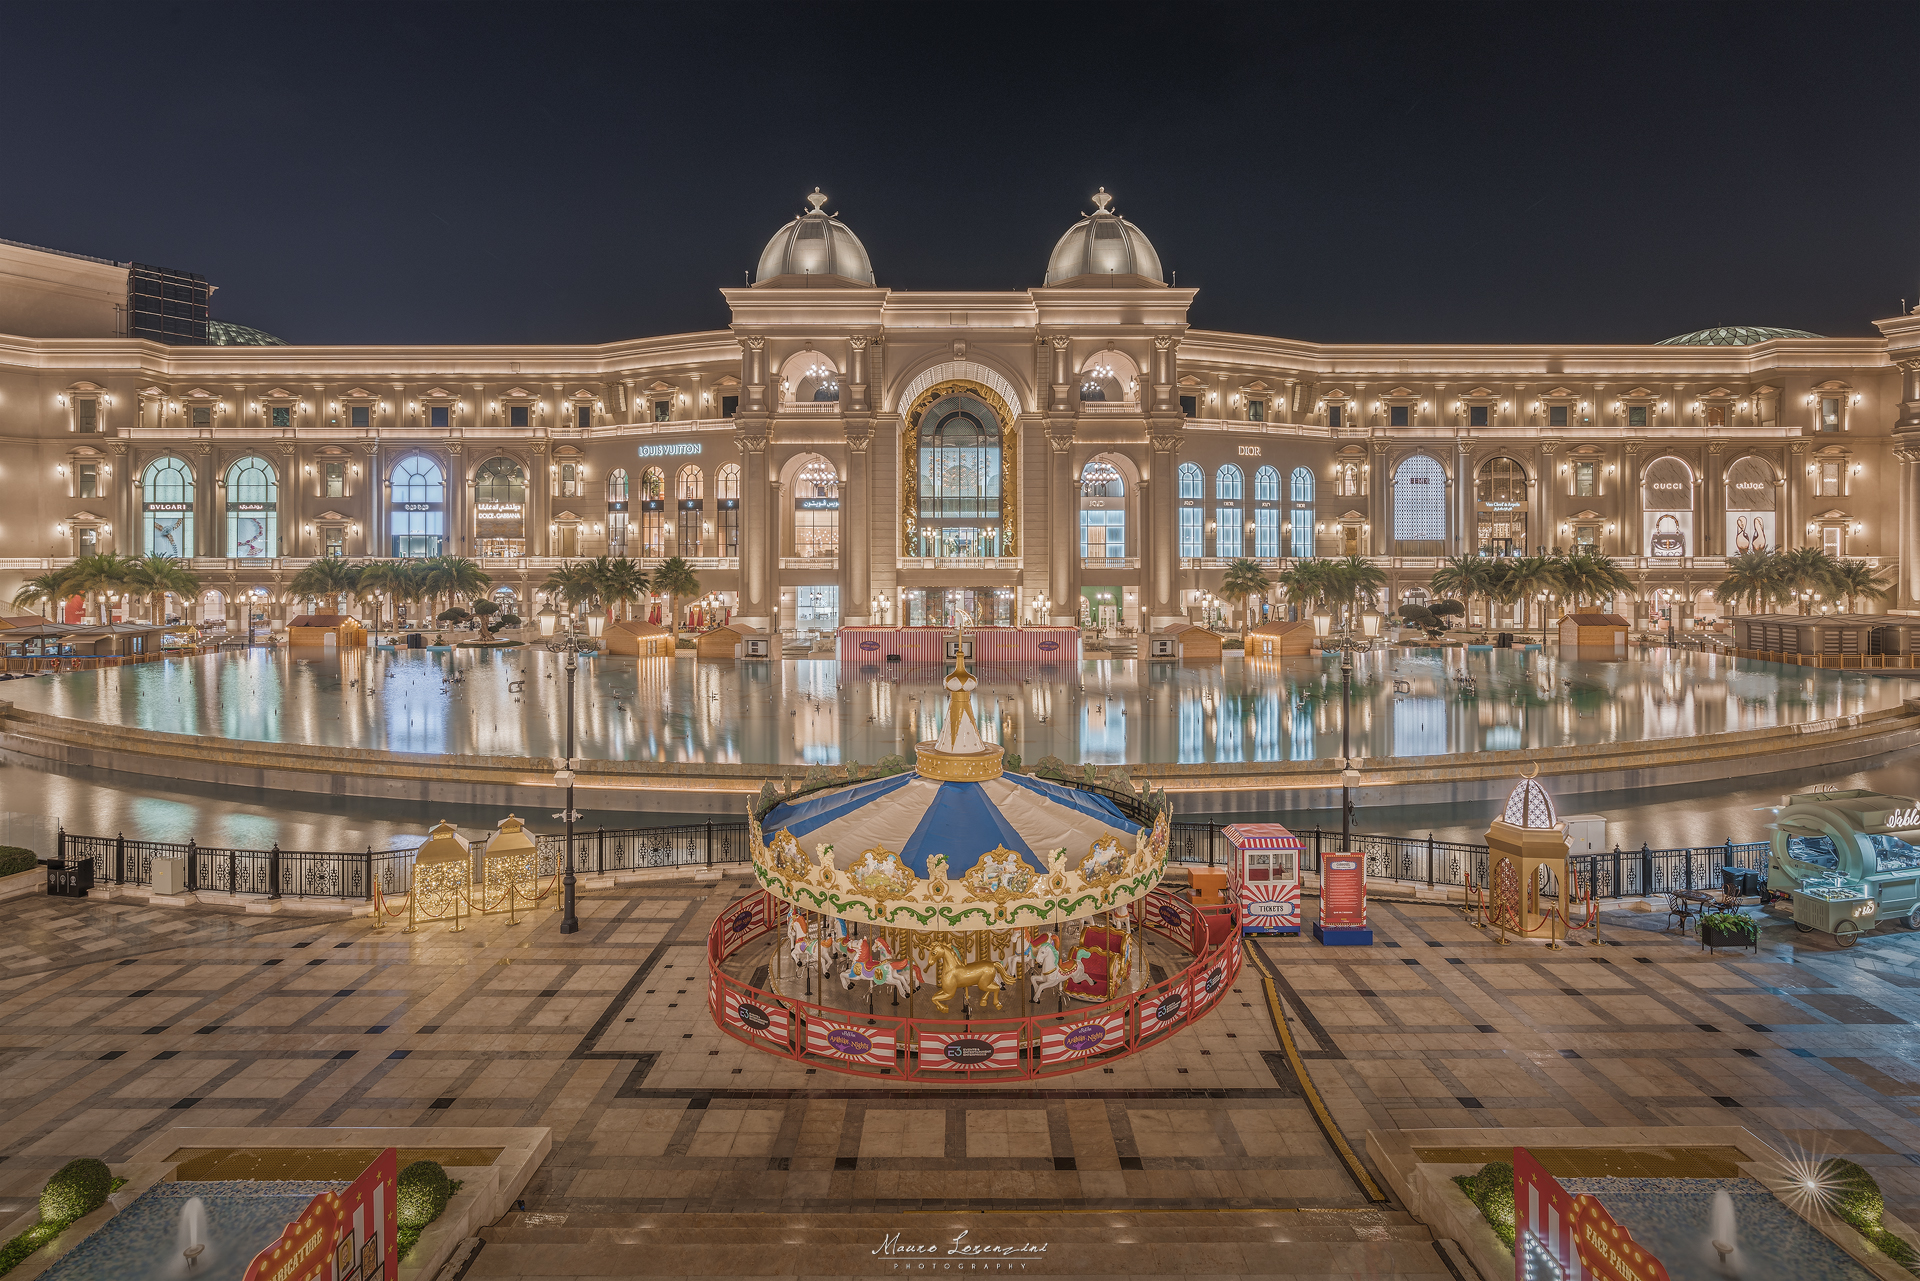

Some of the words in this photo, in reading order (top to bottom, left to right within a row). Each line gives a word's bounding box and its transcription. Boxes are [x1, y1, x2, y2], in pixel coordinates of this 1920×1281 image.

[638, 445, 662, 456] LOUIS
[663, 443, 702, 456] VUITTON
[1238, 445, 1262, 456] DIOR
[1886, 808, 1920, 828] Sable
[1087, 1032, 1104, 1042] Nights
[850, 1041, 869, 1051] Nights
[947, 1045, 962, 1057] E3
[1585, 1223, 1608, 1258] FACE
[269, 1227, 323, 1281] ARICATURE
